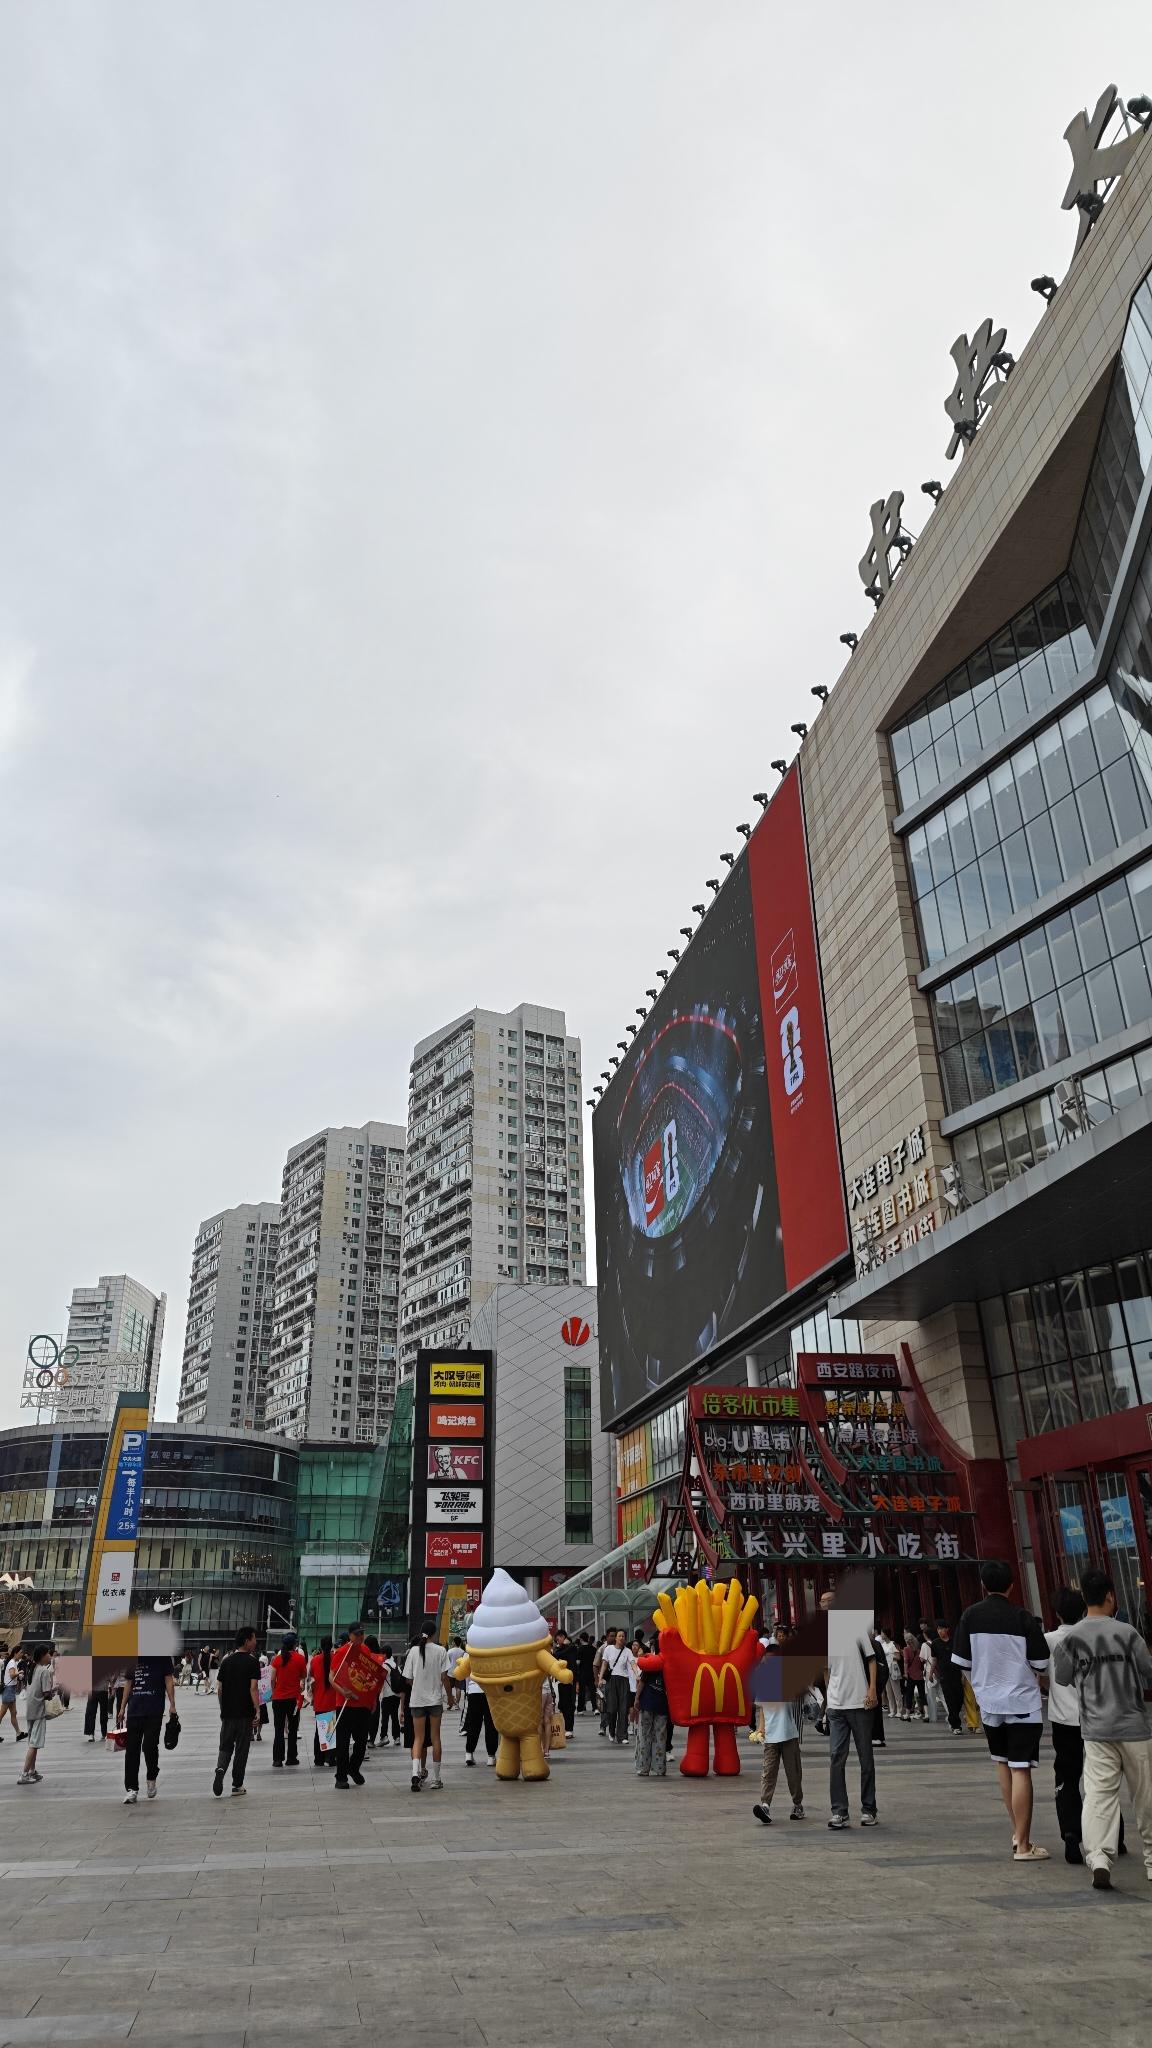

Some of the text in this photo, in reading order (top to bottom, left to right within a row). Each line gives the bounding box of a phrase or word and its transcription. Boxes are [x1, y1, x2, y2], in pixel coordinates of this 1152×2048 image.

[850, 1125, 925, 1211] 大连电子城
[816, 1362, 896, 1379] 西安路夜市
[702, 1392, 800, 1417] 倍客优市集
[122, 1433, 142, 1452] P
[453, 1455, 479, 1465] KFC
[124, 1477, 137, 1517] 每半小时
[730, 1493, 820, 1512] 西市里萌宠
[872, 1496, 961, 1512] 大连电子城
[743, 1531, 960, 1560] 长兴里小吃街
[102, 1588, 126, 1597] 优衣库
